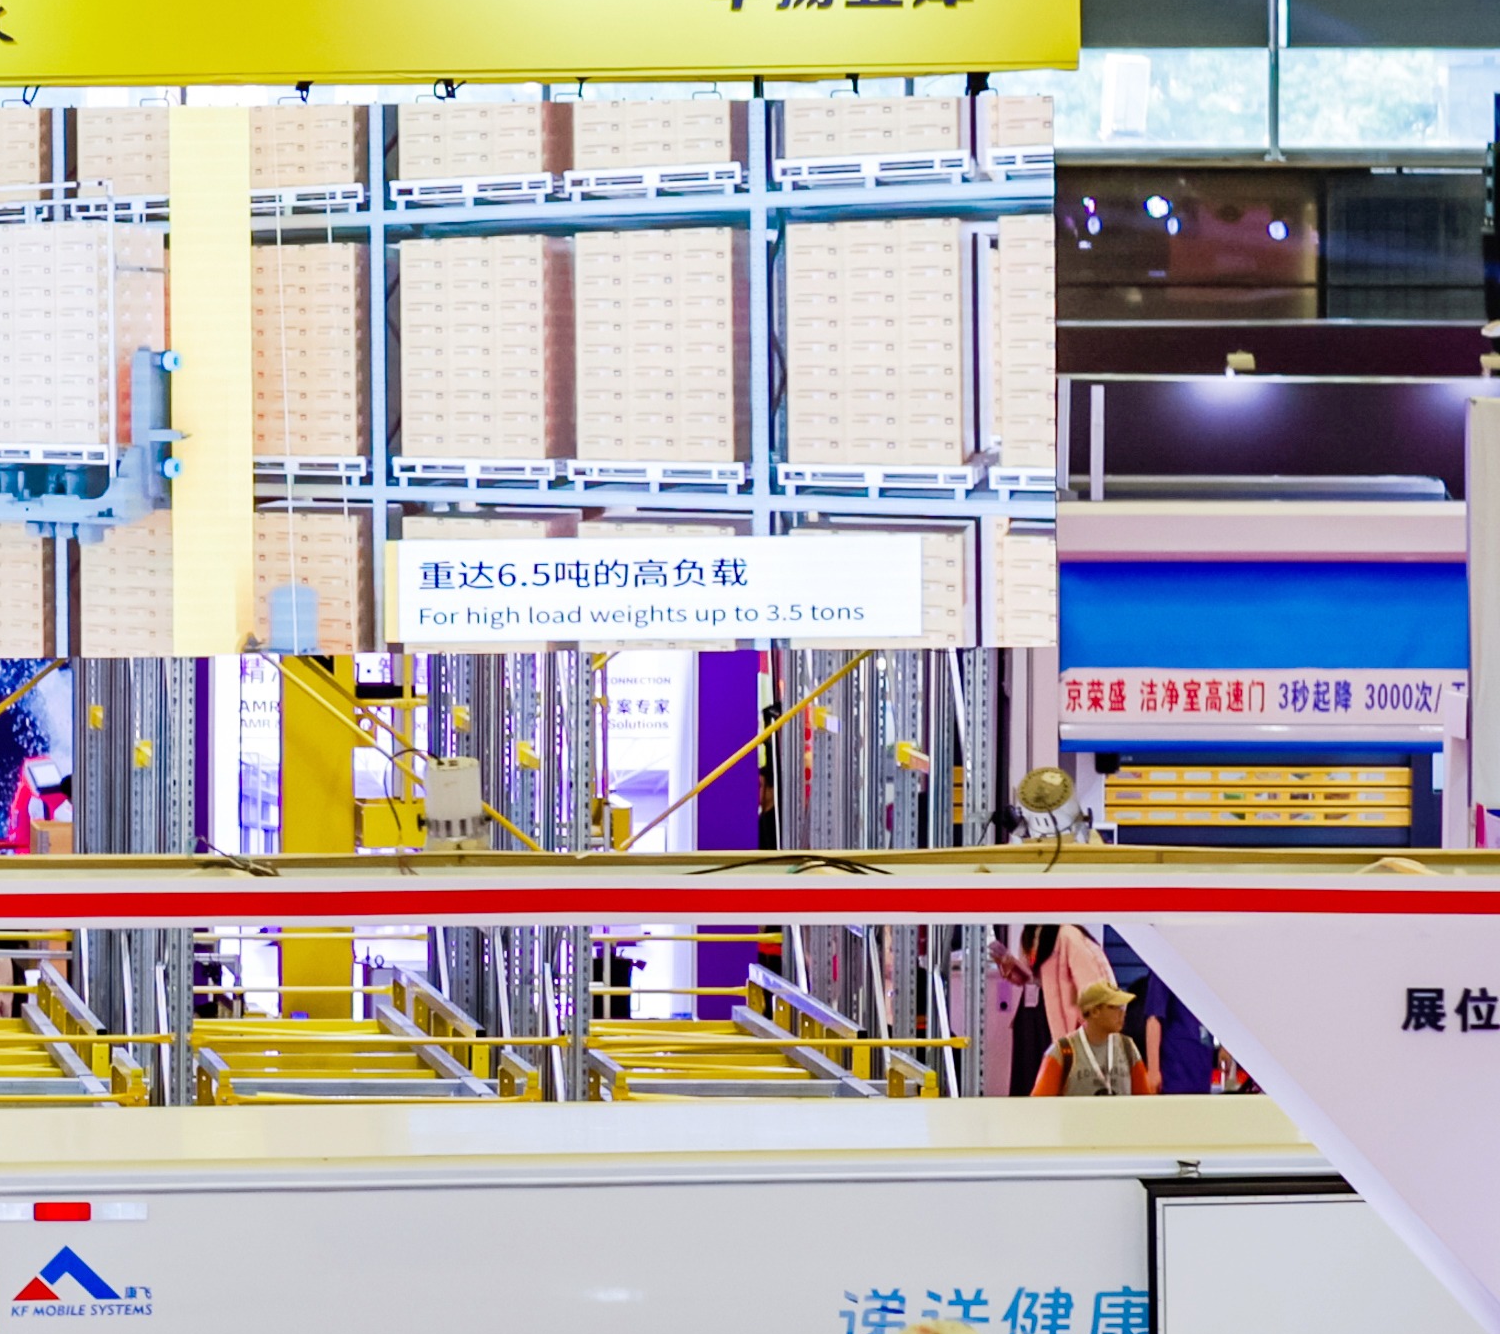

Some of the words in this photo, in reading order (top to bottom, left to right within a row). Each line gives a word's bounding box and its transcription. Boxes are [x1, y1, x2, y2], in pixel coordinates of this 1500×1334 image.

[418, 557, 749, 590] 重达6.5吨的高负载
[418, 605, 459, 627] For
[466, 604, 521, 631] high
[528, 603, 581, 625] load
[590, 603, 688, 630] weights
[694, 606, 727, 628] up
[734, 604, 760, 623] to
[766, 603, 803, 622] 3.5
[810, 602, 865, 622] tons
[602, 698, 670, 715] 案专家
[1064, 679, 1128, 714] 京荣盛
[1139, 678, 1266, 714] 洁净室高速门
[1278, 679, 1352, 714] 3秒起降
[1364, 680, 1467, 714] 3000次/
[124, 1286, 153, 1300] 康飞
[11, 1304, 29, 1318] KF
[33, 1303, 87, 1317] MOBILE
[90, 1303, 153, 1317] SYSTEMS
